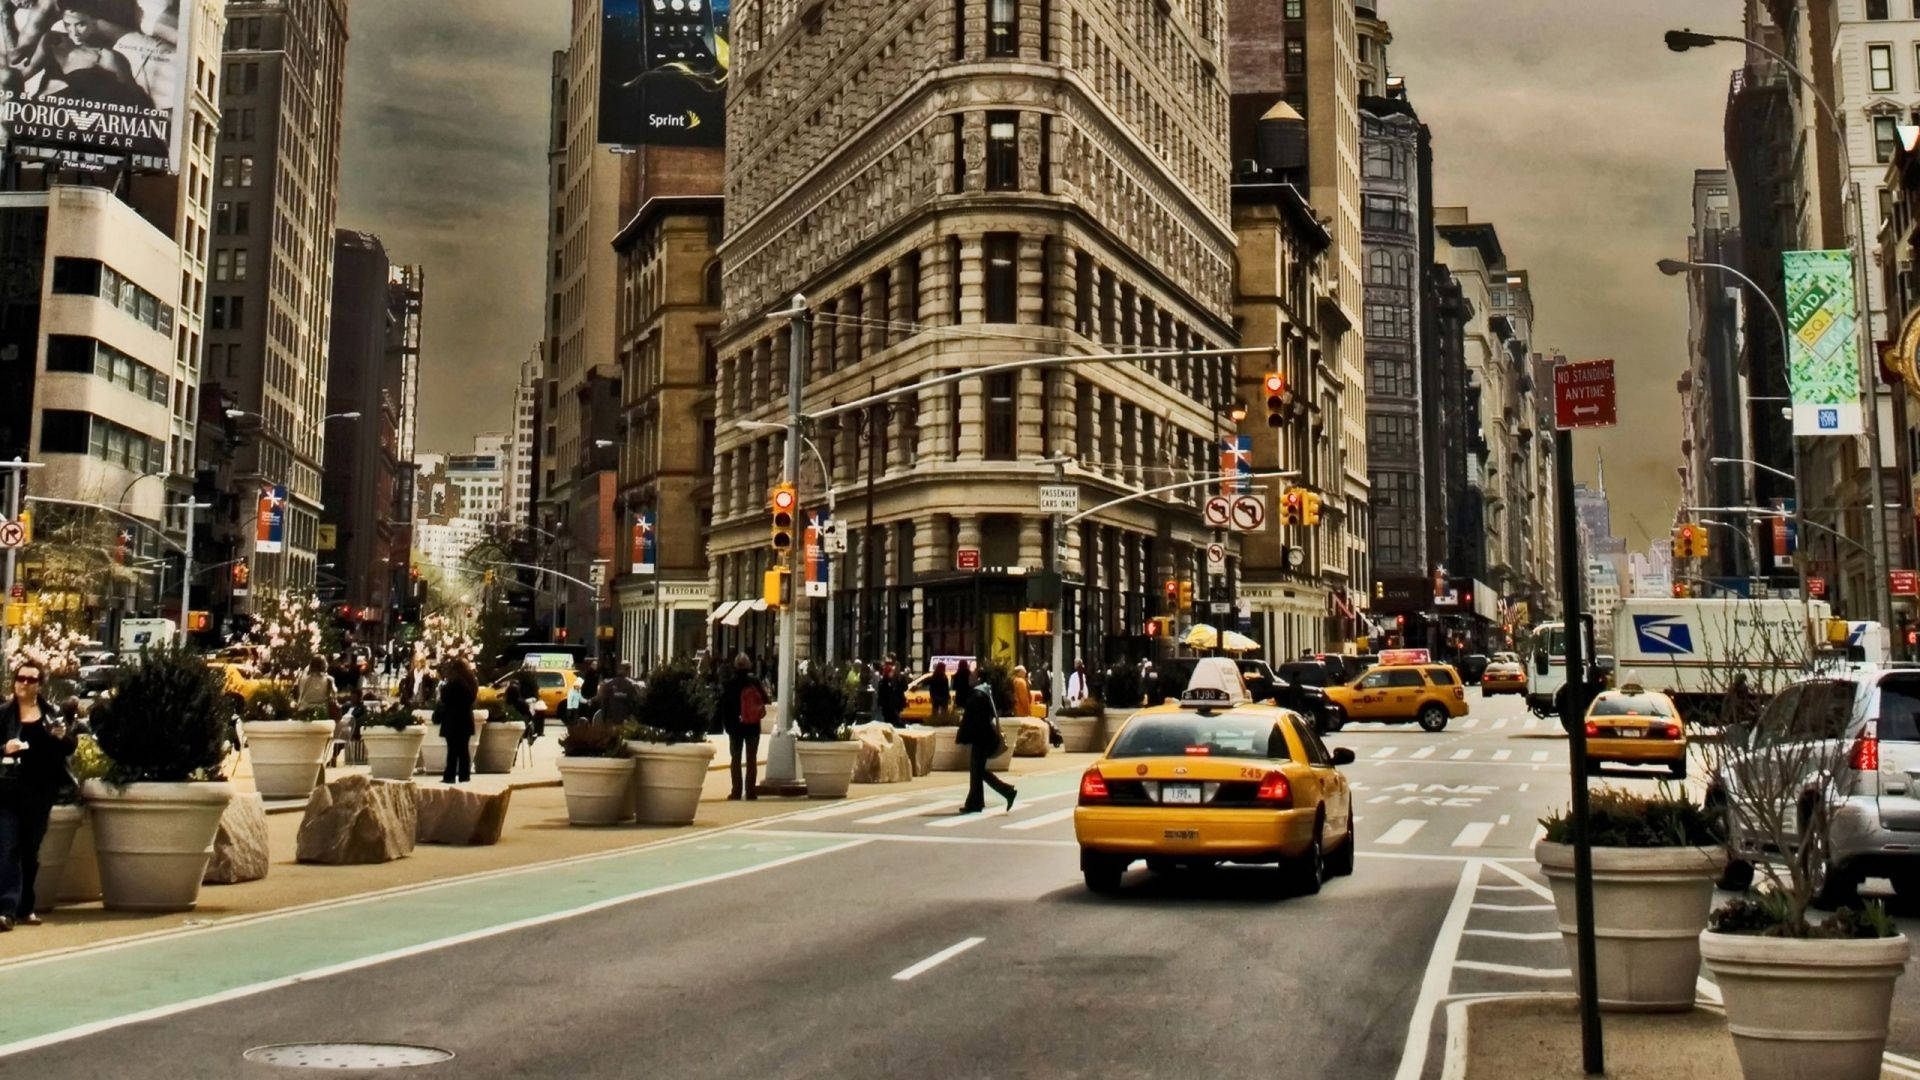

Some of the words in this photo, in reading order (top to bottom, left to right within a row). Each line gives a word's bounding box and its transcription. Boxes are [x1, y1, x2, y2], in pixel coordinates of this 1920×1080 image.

[39, 94, 169, 118] emporioarmani.com
[94, 113, 168, 141] ARMANI
[649, 113, 685, 128] Sprint
[14, 124, 133, 147] UNDERWEAR
[1788, 293, 1824, 328] MAD.
[1803, 319, 1829, 341] SQ.
[1557, 371, 1570, 384] NO
[1572, 366, 1611, 382] STANDING
[1565, 385, 1606, 400] ANYTIME
[1041, 489, 1076, 498] PASSENGER
[1041, 499, 1058, 508] CARS
[1060, 499, 1076, 508] ONLY
[1194, 690, 1215, 700] 1J90
[1240, 767, 1262, 779] 245
